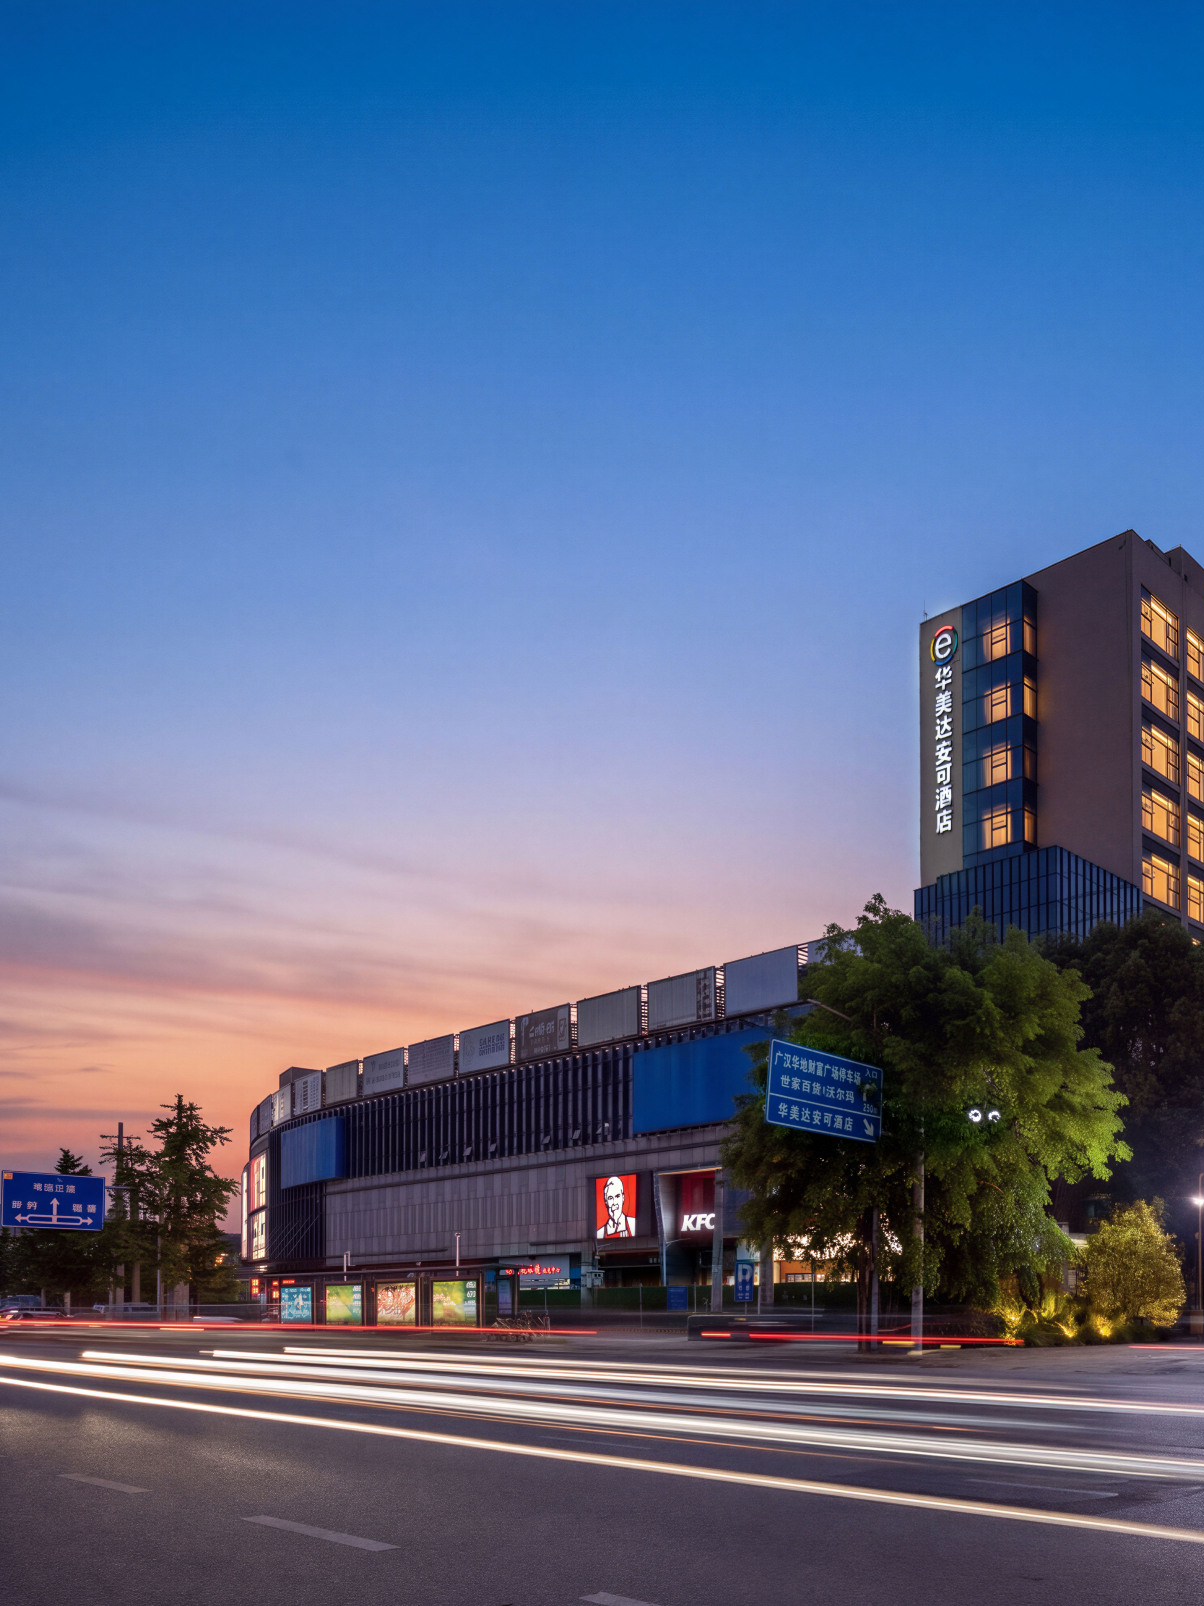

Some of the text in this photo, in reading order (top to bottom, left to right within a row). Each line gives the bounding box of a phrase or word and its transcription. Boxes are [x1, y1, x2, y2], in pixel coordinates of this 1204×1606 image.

[935, 666, 953, 834] 华美达安可酒店
[774, 1050, 862, 1086] 广汉华地财富广场停车场
[865, 1068, 878, 1079] 入口
[778, 1102, 854, 1132] 华美达安可酒店
[681, 1213, 716, 1231] KFC
